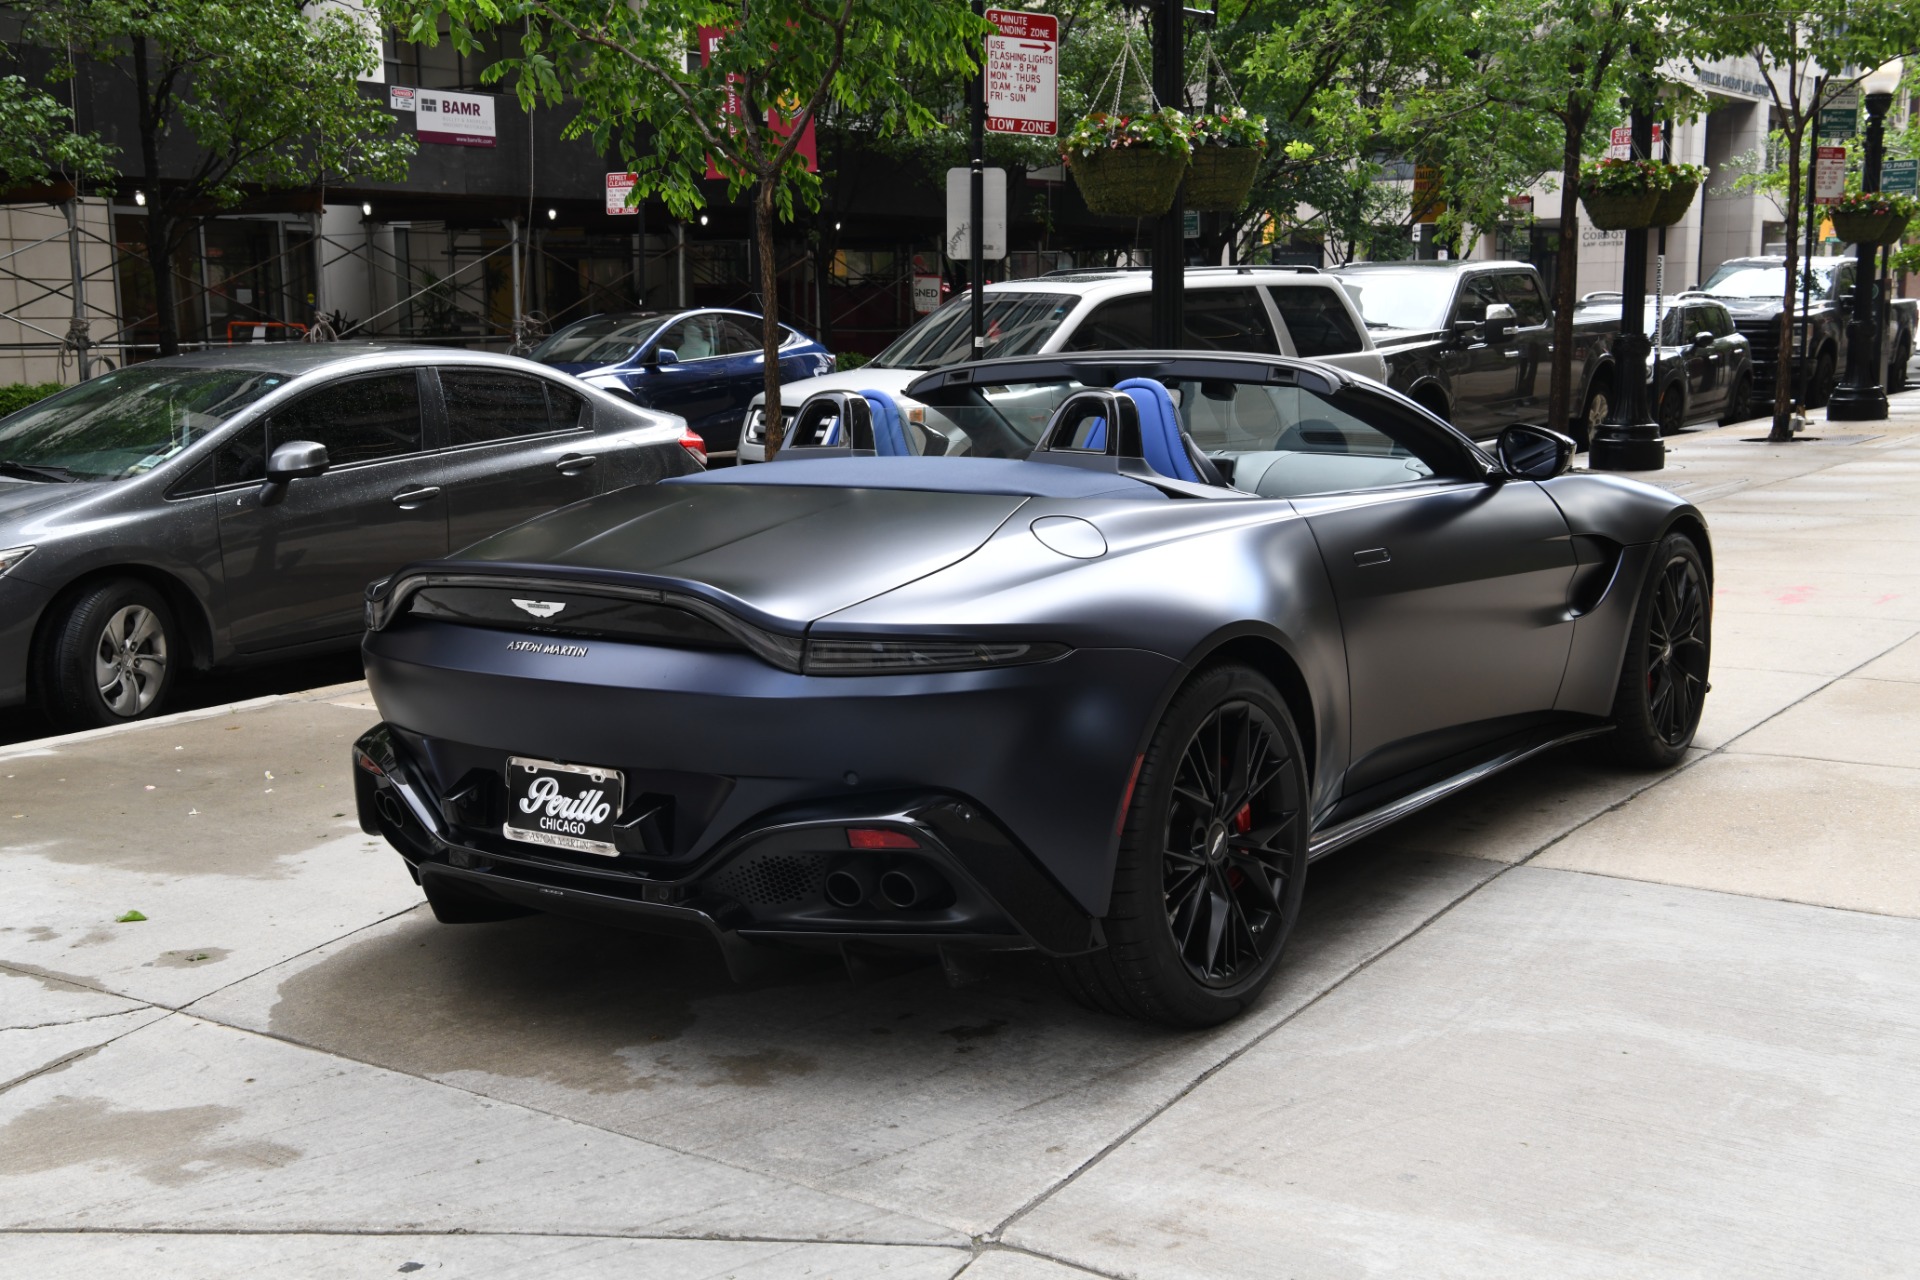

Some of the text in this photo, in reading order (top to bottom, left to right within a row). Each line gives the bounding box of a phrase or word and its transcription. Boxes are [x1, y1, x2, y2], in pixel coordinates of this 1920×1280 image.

[990, 13, 1028, 26] 15 MINUTE
[998, 25, 1050, 39] ANDING ZONE
[990, 41, 1005, 50] USE
[990, 50, 1053, 65] FLASHING LIGHTS
[990, 61, 998, 70] 10
[1000, 62, 1011, 71] AM
[1026, 64, 1038, 73] PM
[990, 71, 1007, 80] MON
[1016, 73, 1041, 84] THURS
[990, 81, 998, 90] 10
[999, 82, 1011, 91] AM
[1019, 84, 1024, 92] 6
[1026, 84, 1037, 93] PM
[990, 91, 1003, 101] FRI
[1010, 93, 1026, 102] SUN
[442, 100, 481, 117] BAMR
[990, 118, 1051, 133] TOW ZONE
[1614, 129, 1632, 137] STR
[506, 641, 589, 657] ASTON MARTIN
[519, 777, 610, 824] Perillo
[540, 817, 586, 835] CHICAGO
